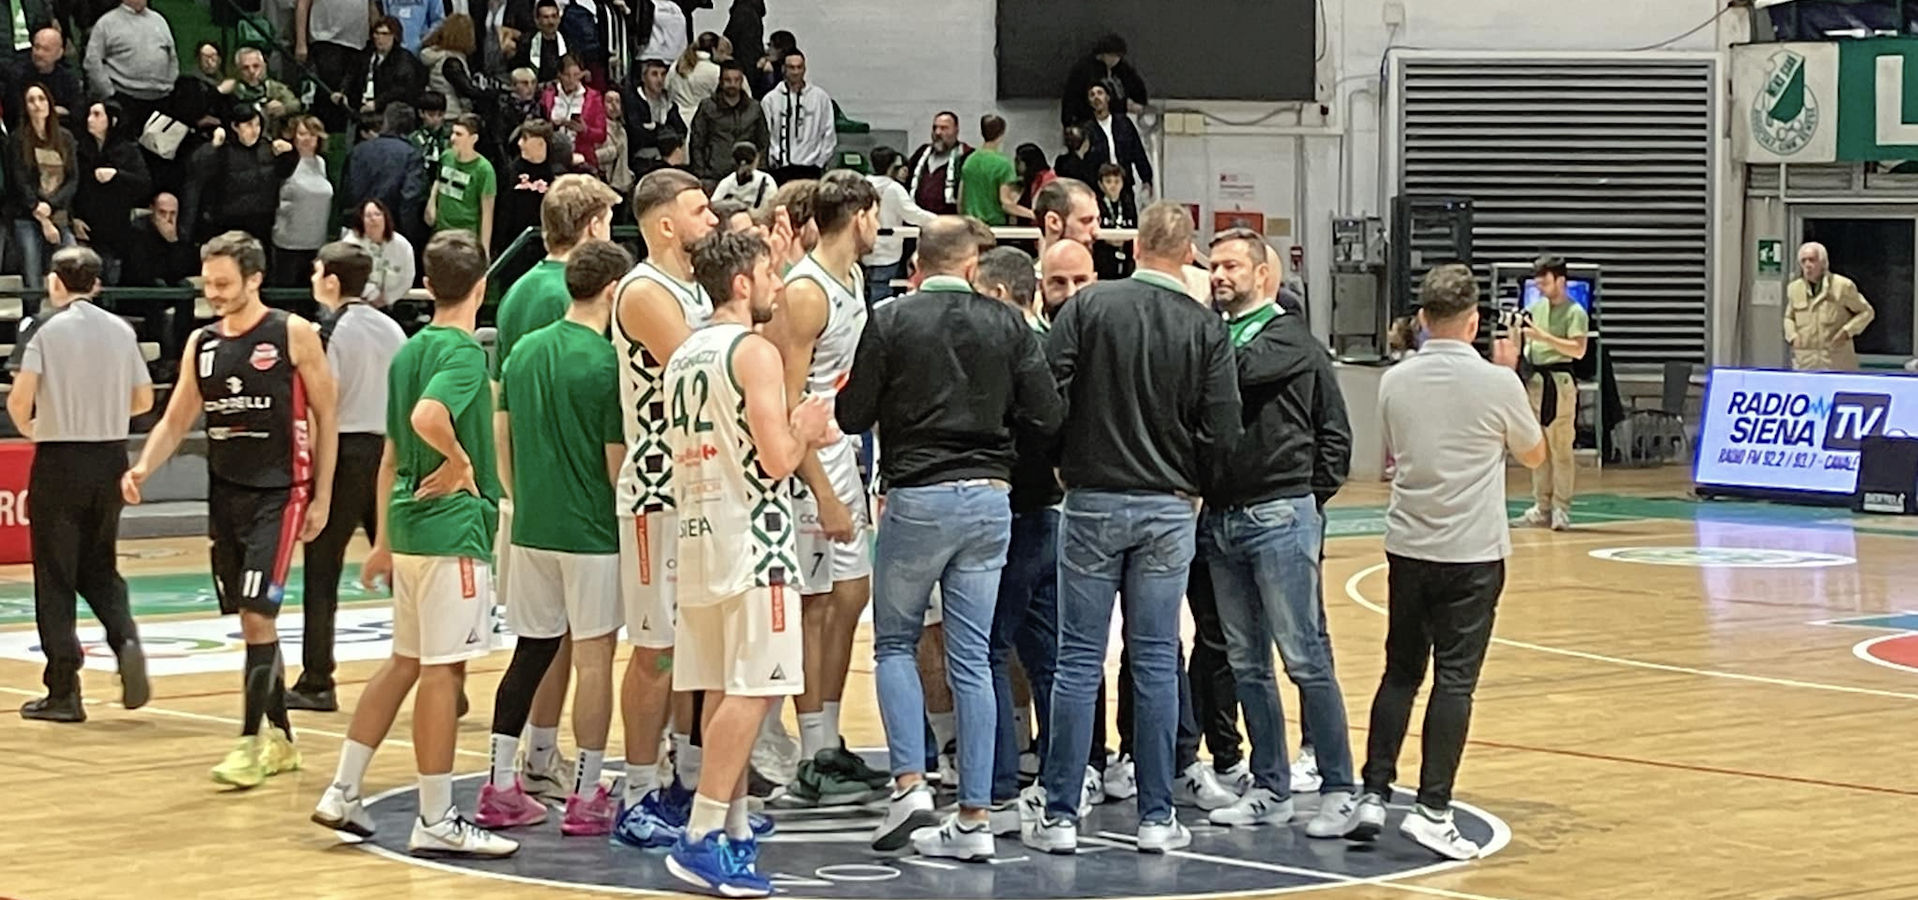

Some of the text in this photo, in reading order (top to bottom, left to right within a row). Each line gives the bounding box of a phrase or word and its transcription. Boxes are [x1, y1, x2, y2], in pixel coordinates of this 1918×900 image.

[671, 369, 714, 437] 42
[1727, 391, 1810, 417] RADIO
[1729, 417, 1815, 447] SIENA
[1834, 404, 1885, 440] TV
[810, 552, 825, 578] 7
[242, 570, 263, 598] 11
